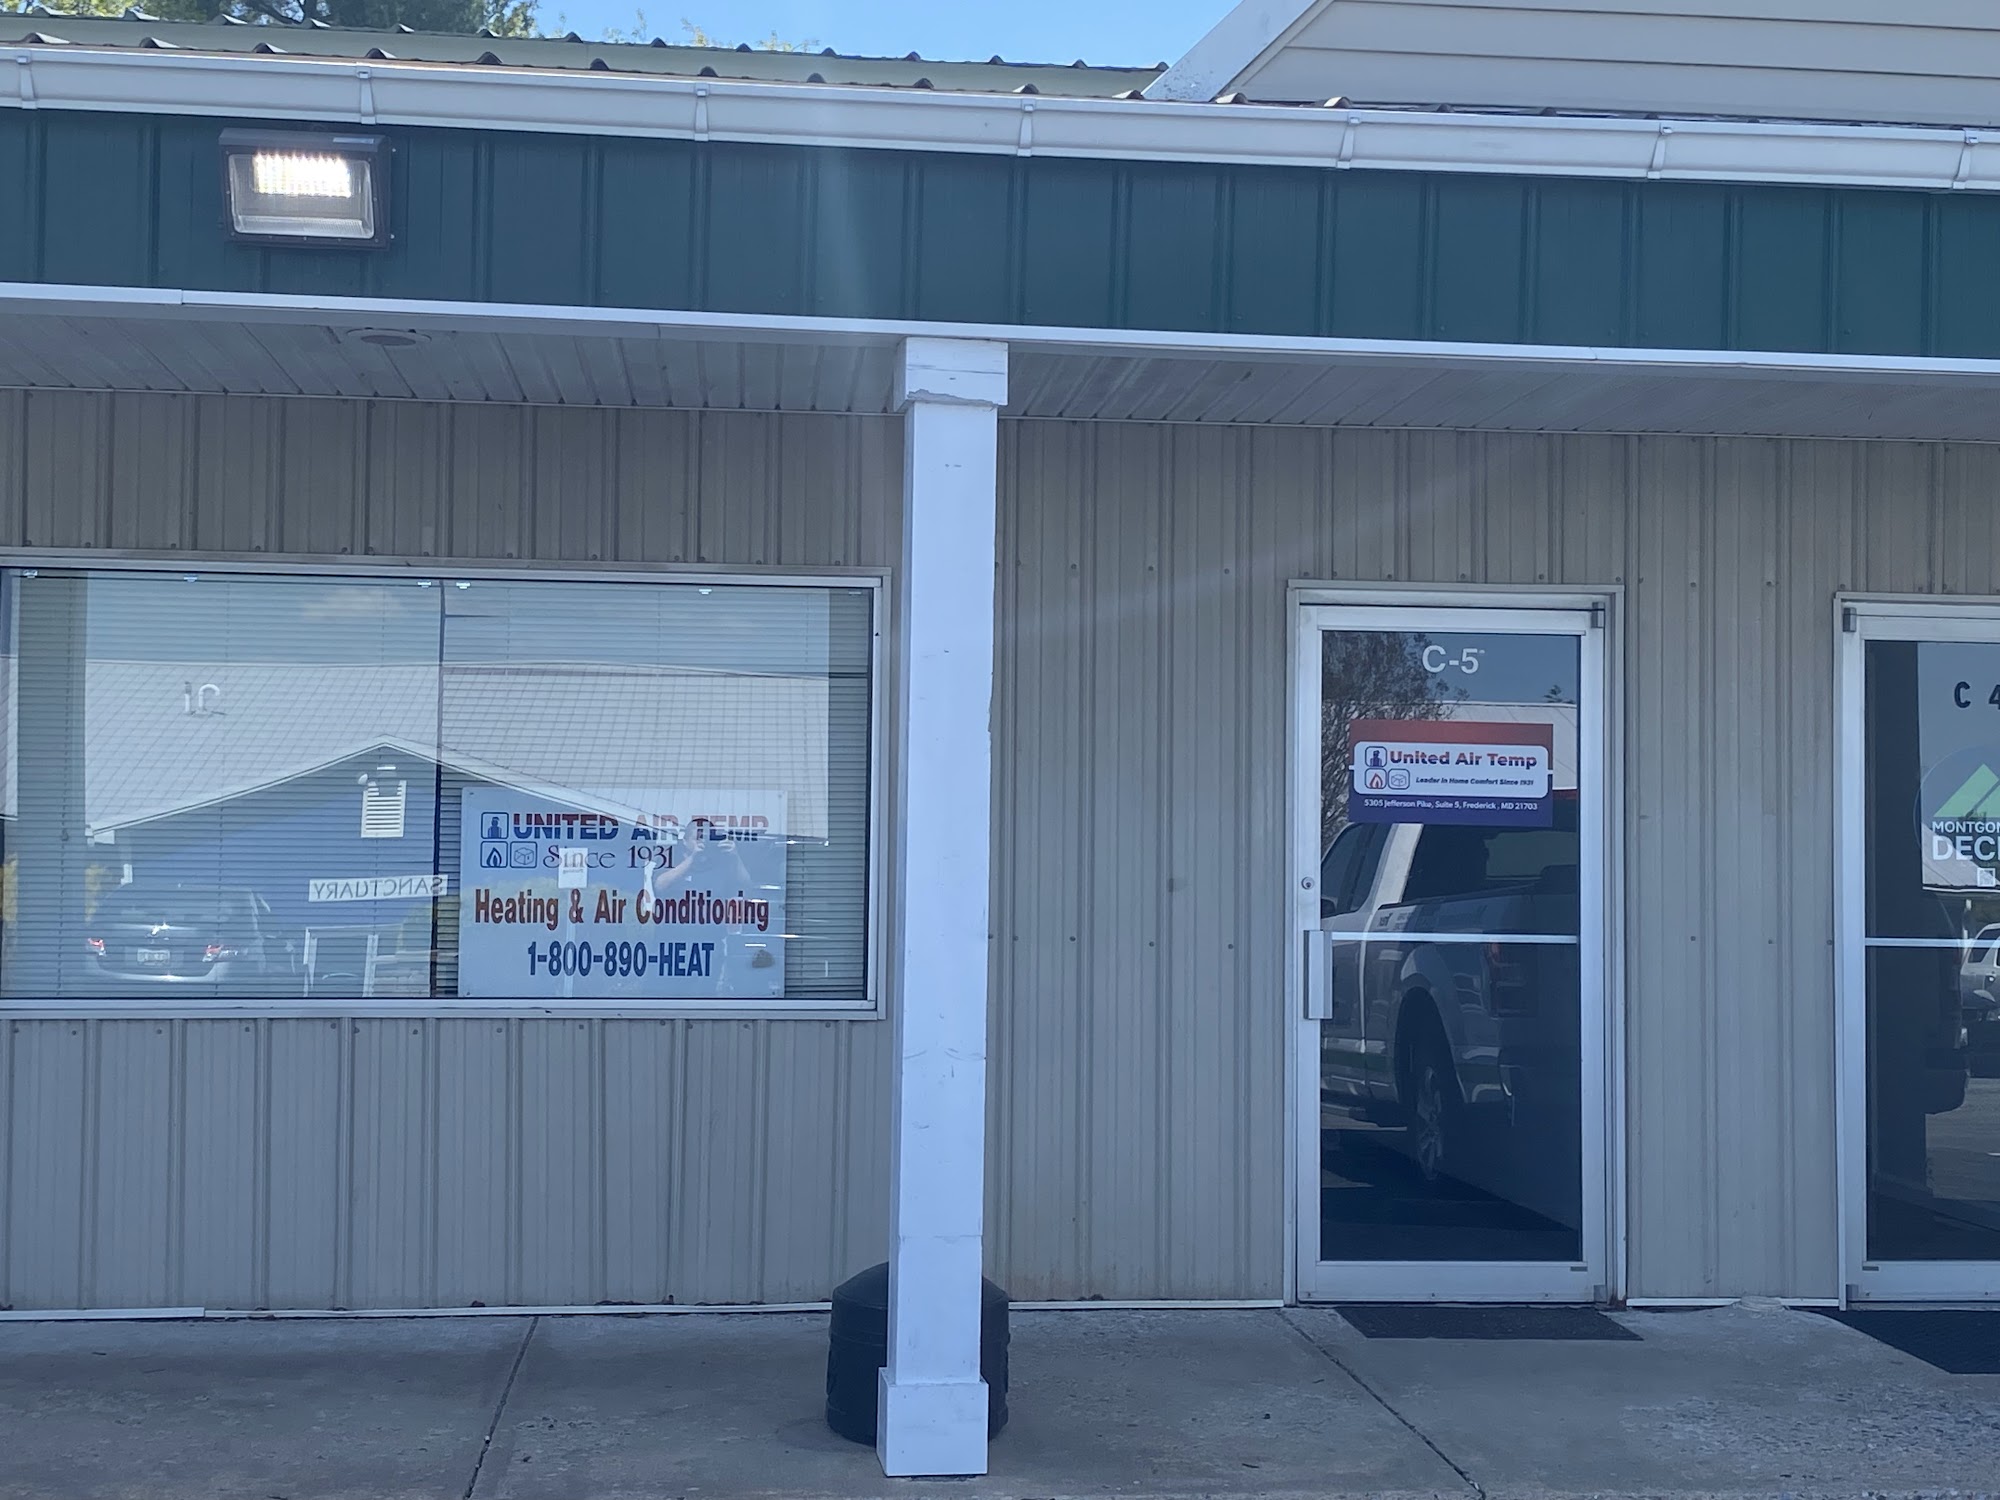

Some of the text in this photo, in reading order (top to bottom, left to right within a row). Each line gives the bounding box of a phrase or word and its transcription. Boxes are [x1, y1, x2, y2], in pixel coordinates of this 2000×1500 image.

[1422, 645, 1479, 674] C-5
[1953, 681, 1971, 709] C
[1389, 750, 1538, 770] United Air Temp
[1364, 799, 1384, 807] 5305
[1384, 800, 1416, 808] Jefferson
[1416, 801, 1434, 809] Pike,
[1434, 801, 1454, 809] Suite
[1454, 801, 1462, 809] 5,
[513, 813, 769, 842] UNITED AIR TEMP
[543, 845, 675, 869] Since 1931
[475, 888, 769, 932] Heating & Air Conditioning
[527, 941, 715, 977] 1-800-890-HEAT
